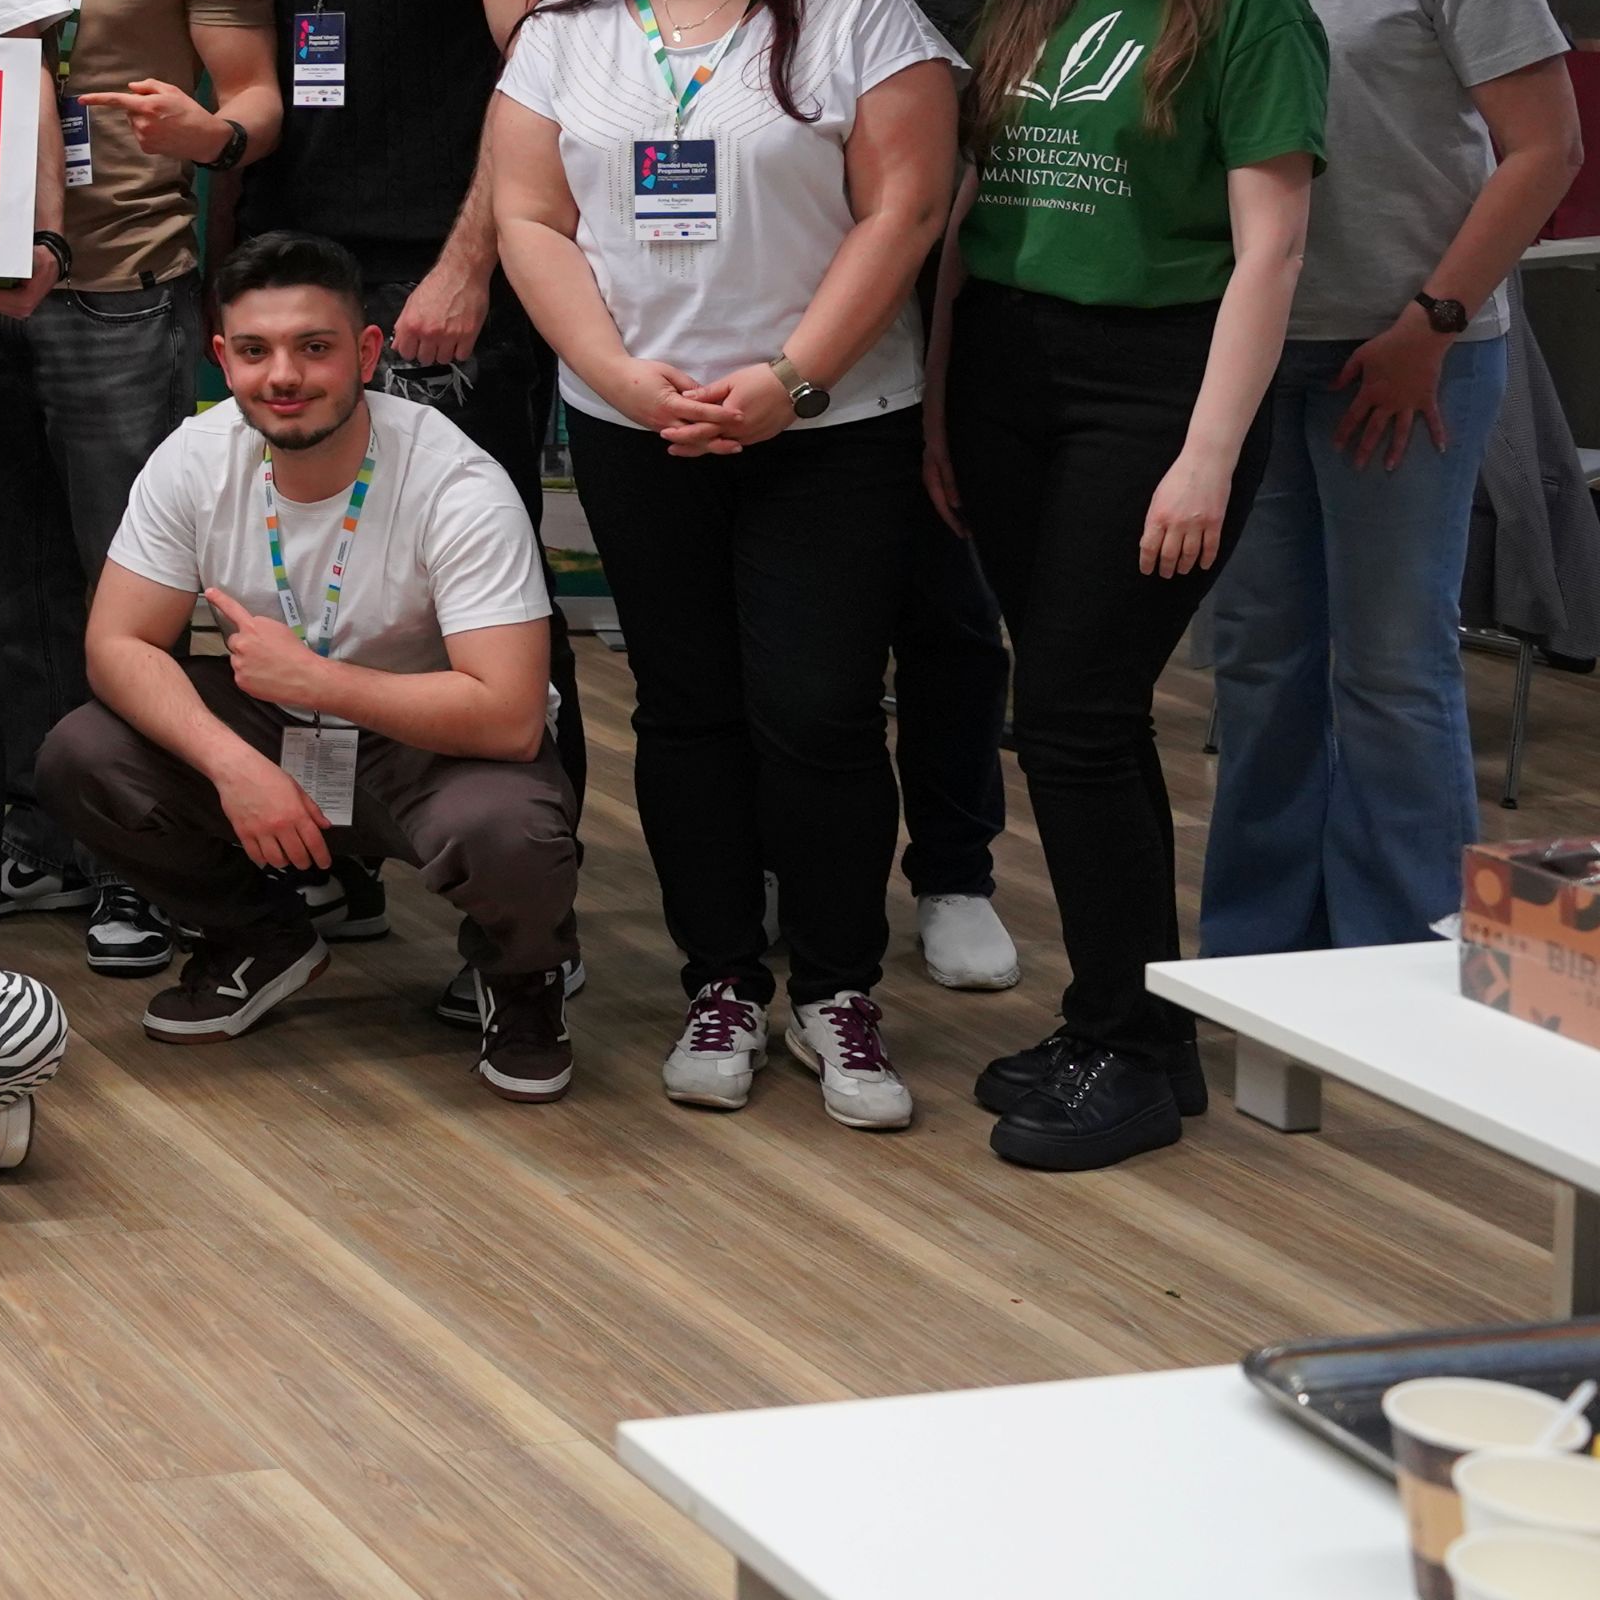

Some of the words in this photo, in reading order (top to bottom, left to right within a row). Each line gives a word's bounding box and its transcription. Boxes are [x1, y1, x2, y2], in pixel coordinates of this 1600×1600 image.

[1005, 125, 1081, 145] WYDZIAŁ
[1007, 147, 1128, 174] SPOŁECZNYCH
[982, 168, 1133, 197] MANISTYCZNYCH
[978, 195, 1029, 207] AKADEMII
